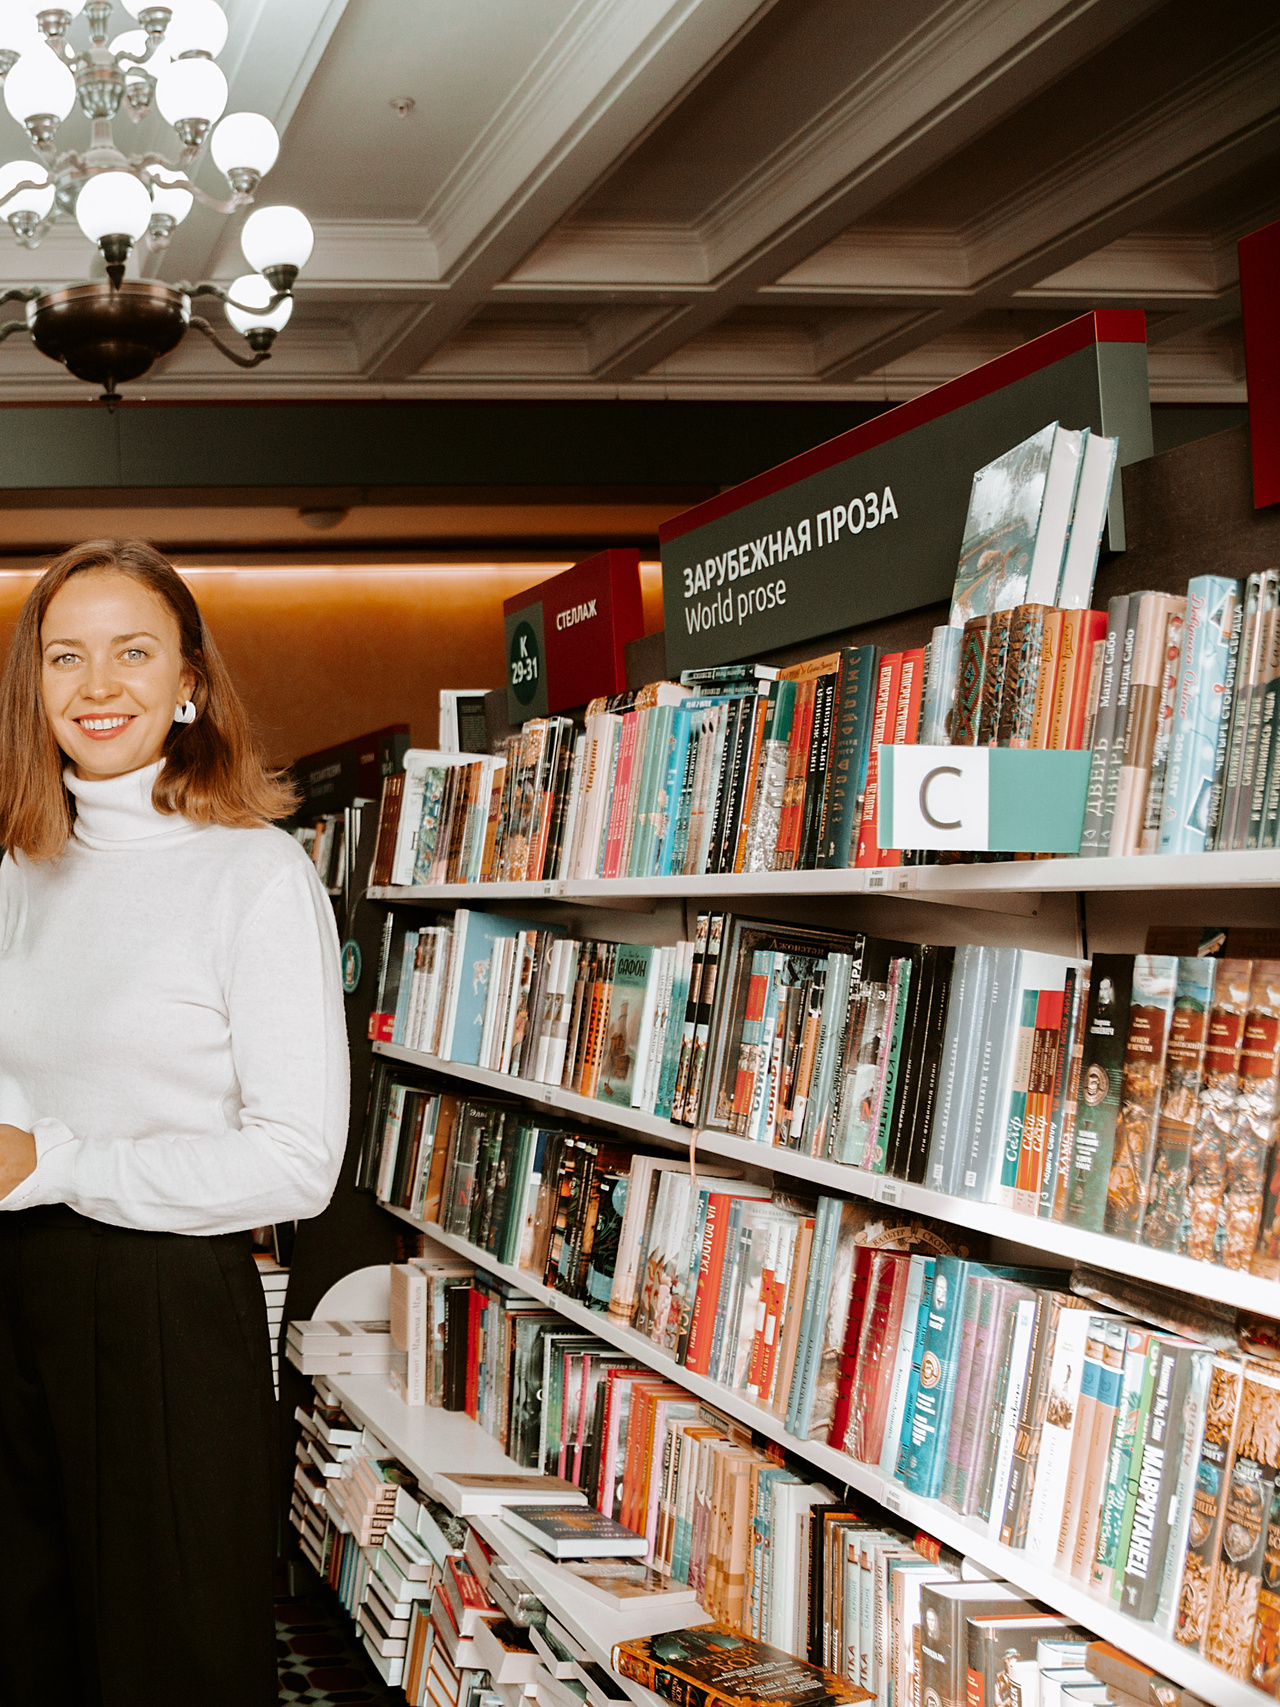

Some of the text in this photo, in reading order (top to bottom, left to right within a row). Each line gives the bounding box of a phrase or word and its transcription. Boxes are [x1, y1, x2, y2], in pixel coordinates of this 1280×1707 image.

[683, 486, 899, 599] ЗАРУБЕЖНАЯ ПРОЗА
[556, 599, 598, 631] СТЕЛЛАЖ
[684, 580, 787, 635] World prose
[511, 657, 539, 685] 29-31
[1099, 631, 1117, 708] Магда Сабо
[1117, 628, 1136, 707] Магда Сабо
[1178, 592, 1206, 719] Девушка Online
[1214, 604, 1244, 771] ЧЕТЫРЕ СТОРОНЫ СЕРДЦА
[1263, 691, 1276, 723] ЧАША
[819, 739, 828, 771] ПЯТЬ
[1227, 699, 1247, 789] СИНЯКИ НА ДУШЕ
[1242, 697, 1262, 786] СИНЯКИ НА ДУШЕ
[919, 766, 963, 830] С
[1086, 738, 1109, 817] ДВЕРЬ
[1103, 736, 1126, 814] ДВЕРЬ
[862, 781, 877, 822] ЧЕЛОВЕК
[617, 957, 647, 977] САФОН
[770, 938, 824, 956] Джонатан
[1064, 979, 1074, 1015] ЖИЗНЬ
[1061, 1018, 1070, 1044] МОЮ
[1055, 1046, 1067, 1097] ИЗМЕНИЛ
[1005, 1115, 1024, 1162] Селф
[1021, 1113, 1036, 1151] Селф
[1032, 1114, 1047, 1153] Селф
[698, 1204, 717, 1276] НА ВОЛОСКЕ
[871, 1228, 906, 1248] ВАЛЬТЕР
[673, 1436, 682, 1471] СПАРКС
[1182, 1400, 1199, 1467] АДЕЛЬ
[1124, 1444, 1165, 1580] МАВРИТАНЕЦ
[877, 1593, 885, 1668] ФАМИЛЬНЫЙ
[686, 1646, 759, 1667] РЕЧНОЙ
[713, 1655, 761, 1672] БОГ
